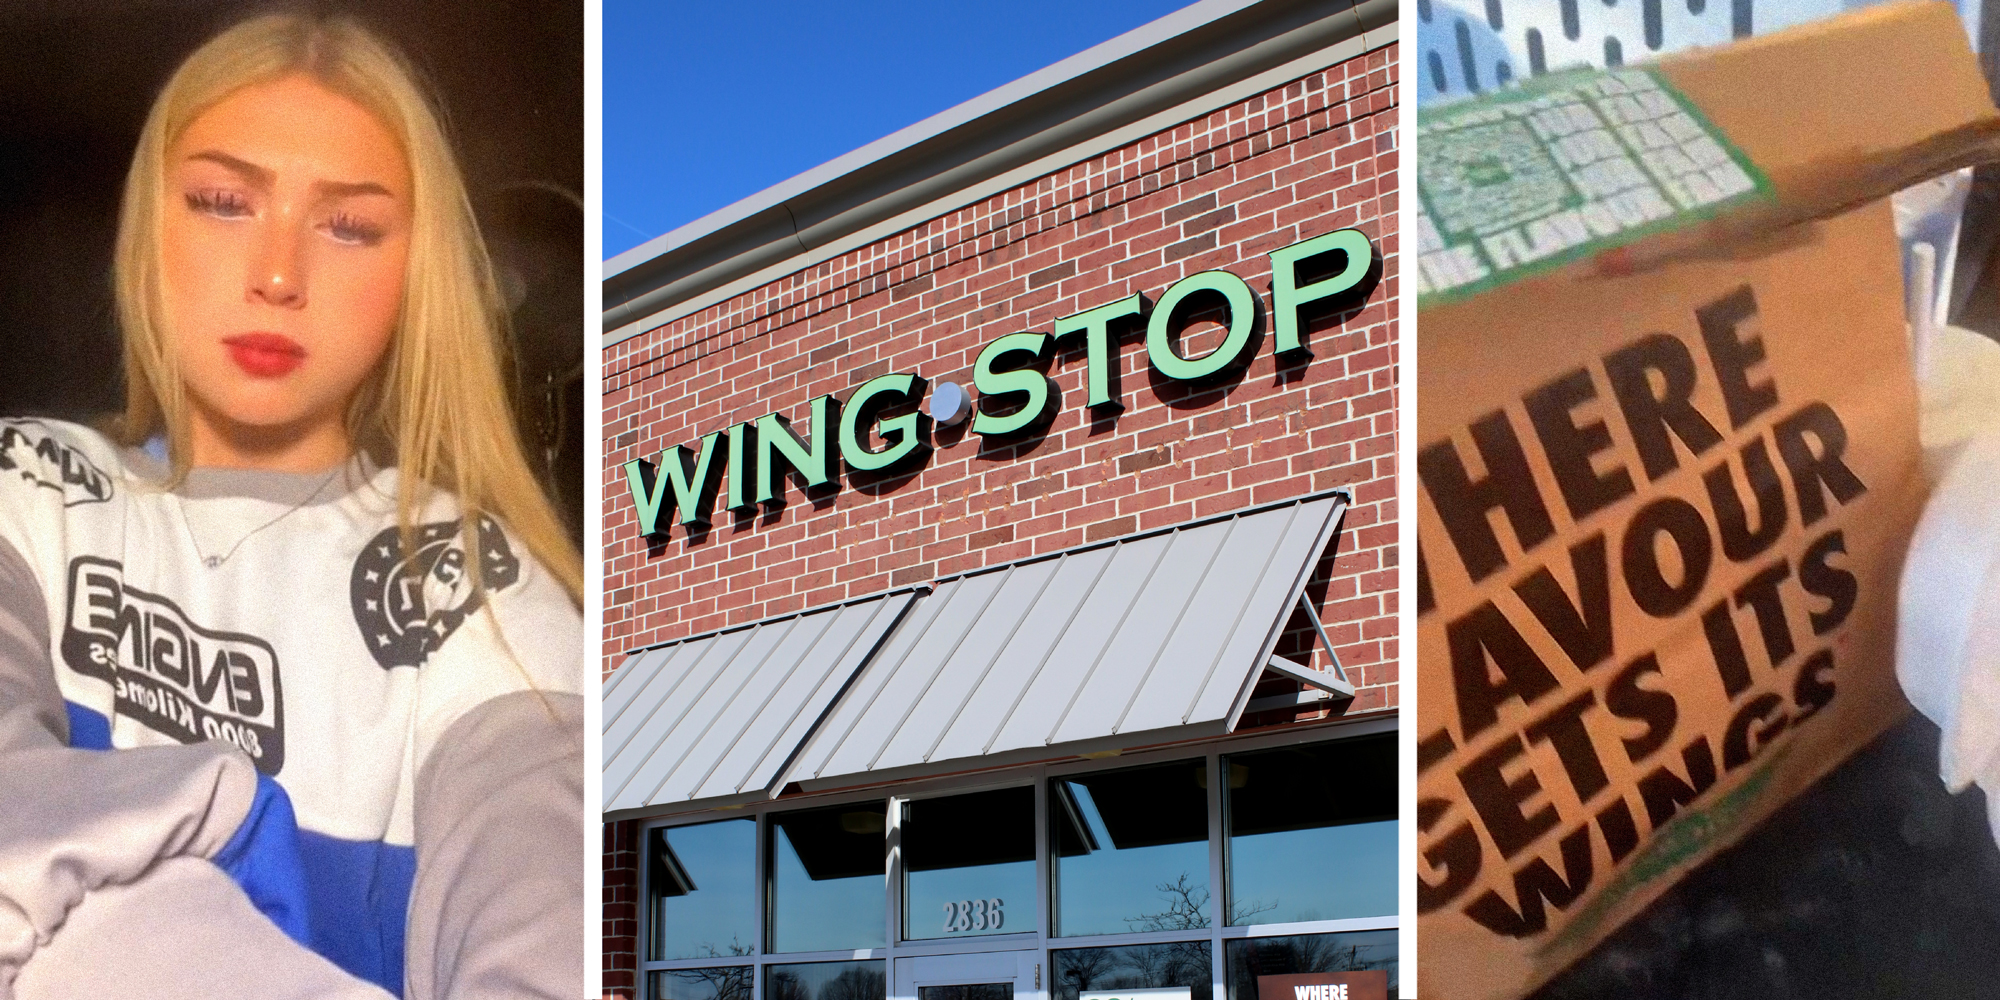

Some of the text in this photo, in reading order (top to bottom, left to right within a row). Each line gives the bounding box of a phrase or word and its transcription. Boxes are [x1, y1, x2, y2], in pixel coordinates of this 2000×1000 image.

[623, 228, 1376, 538] WING STOP
[1417, 284, 1778, 617] HERE
[1417, 401, 1868, 773] AVOUR
[1702, 529, 1858, 701] ITS
[943, 898, 1003, 932] 2836
[1463, 647, 1836, 939] WINGS
[1294, 984, 1349, 1000] WHERE
